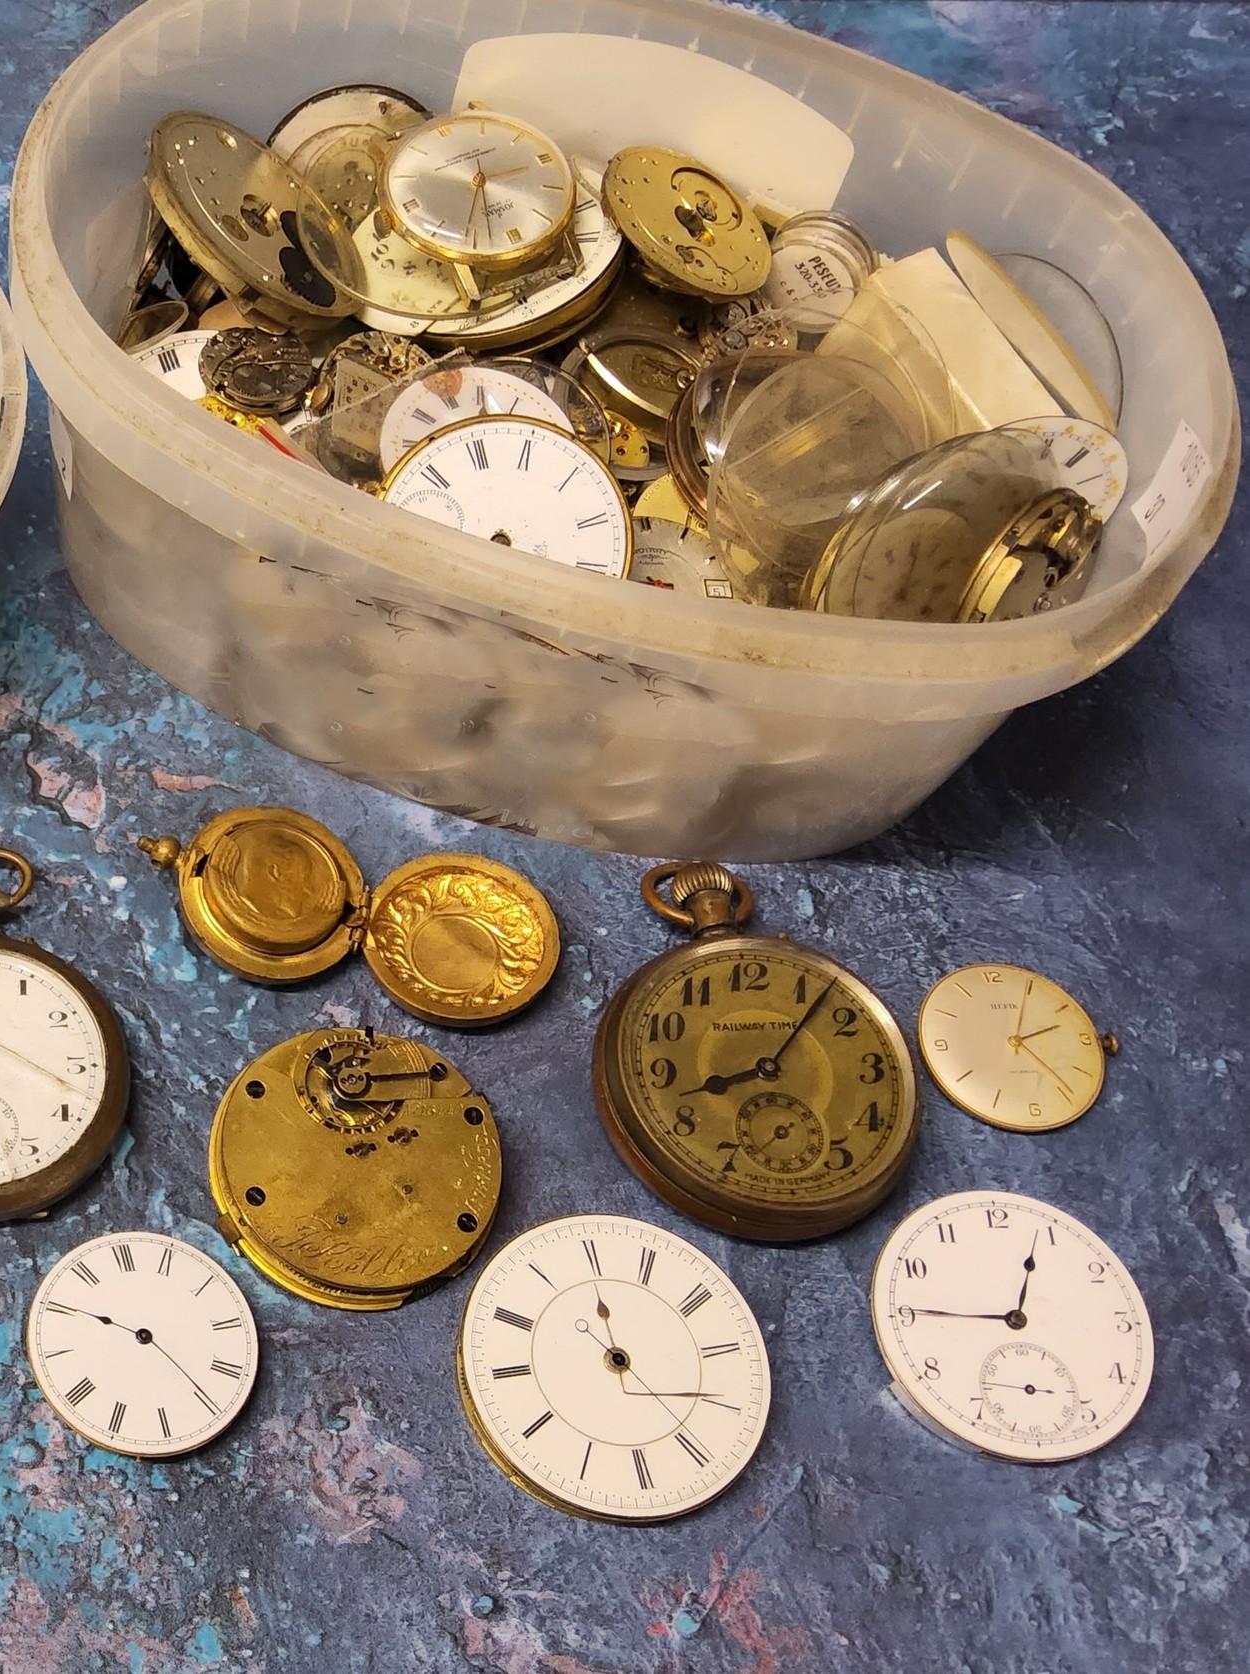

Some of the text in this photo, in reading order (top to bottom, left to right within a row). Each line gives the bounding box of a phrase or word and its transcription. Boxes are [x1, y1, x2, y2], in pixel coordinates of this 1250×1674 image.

[808, 255, 842, 295] PESEUX
[19, 979, 28, 996] 1
[730, 962, 770, 992] 12
[982, 971, 1003, 983] 12
[680, 976, 711, 1008] 11
[793, 974, 807, 1005] 1
[48, 1011, 69, 1029] 2
[649, 1011, 686, 1043] 10
[712, 1020, 798, 1032] RAILWAY TIME
[832, 1007, 858, 1037] 2
[934, 1039, 948, 1052] 9
[1079, 1032, 1091, 1046] 3
[67, 1056, 87, 1075] 3
[650, 1057, 678, 1090] 9
[859, 1052, 885, 1084] 3
[50, 1103, 74, 1122] 4
[672, 1105, 696, 1137] 8
[854, 1101, 885, 1133] 4
[1028, 1102, 1042, 1117] 6
[18, 1136, 40, 1157] 5
[717, 1140, 742, 1173] 7
[823, 1137, 853, 1171] 5
[745, 1171, 831, 1186] MADE IN GERMANY
[985, 1208, 1009, 1229] 12
[937, 1223, 957, 1244] 11
[1047, 1225, 1057, 1246] 1
[904, 1257, 927, 1280] 10
[1088, 1261, 1106, 1284] 2
[898, 1304, 916, 1328] 9
[1114, 1311, 1133, 1333] 3
[924, 1356, 941, 1381] 8
[1108, 1362, 1127, 1385] 4
[969, 1397, 984, 1420] 7
[1080, 1398, 1097, 1423] 5
